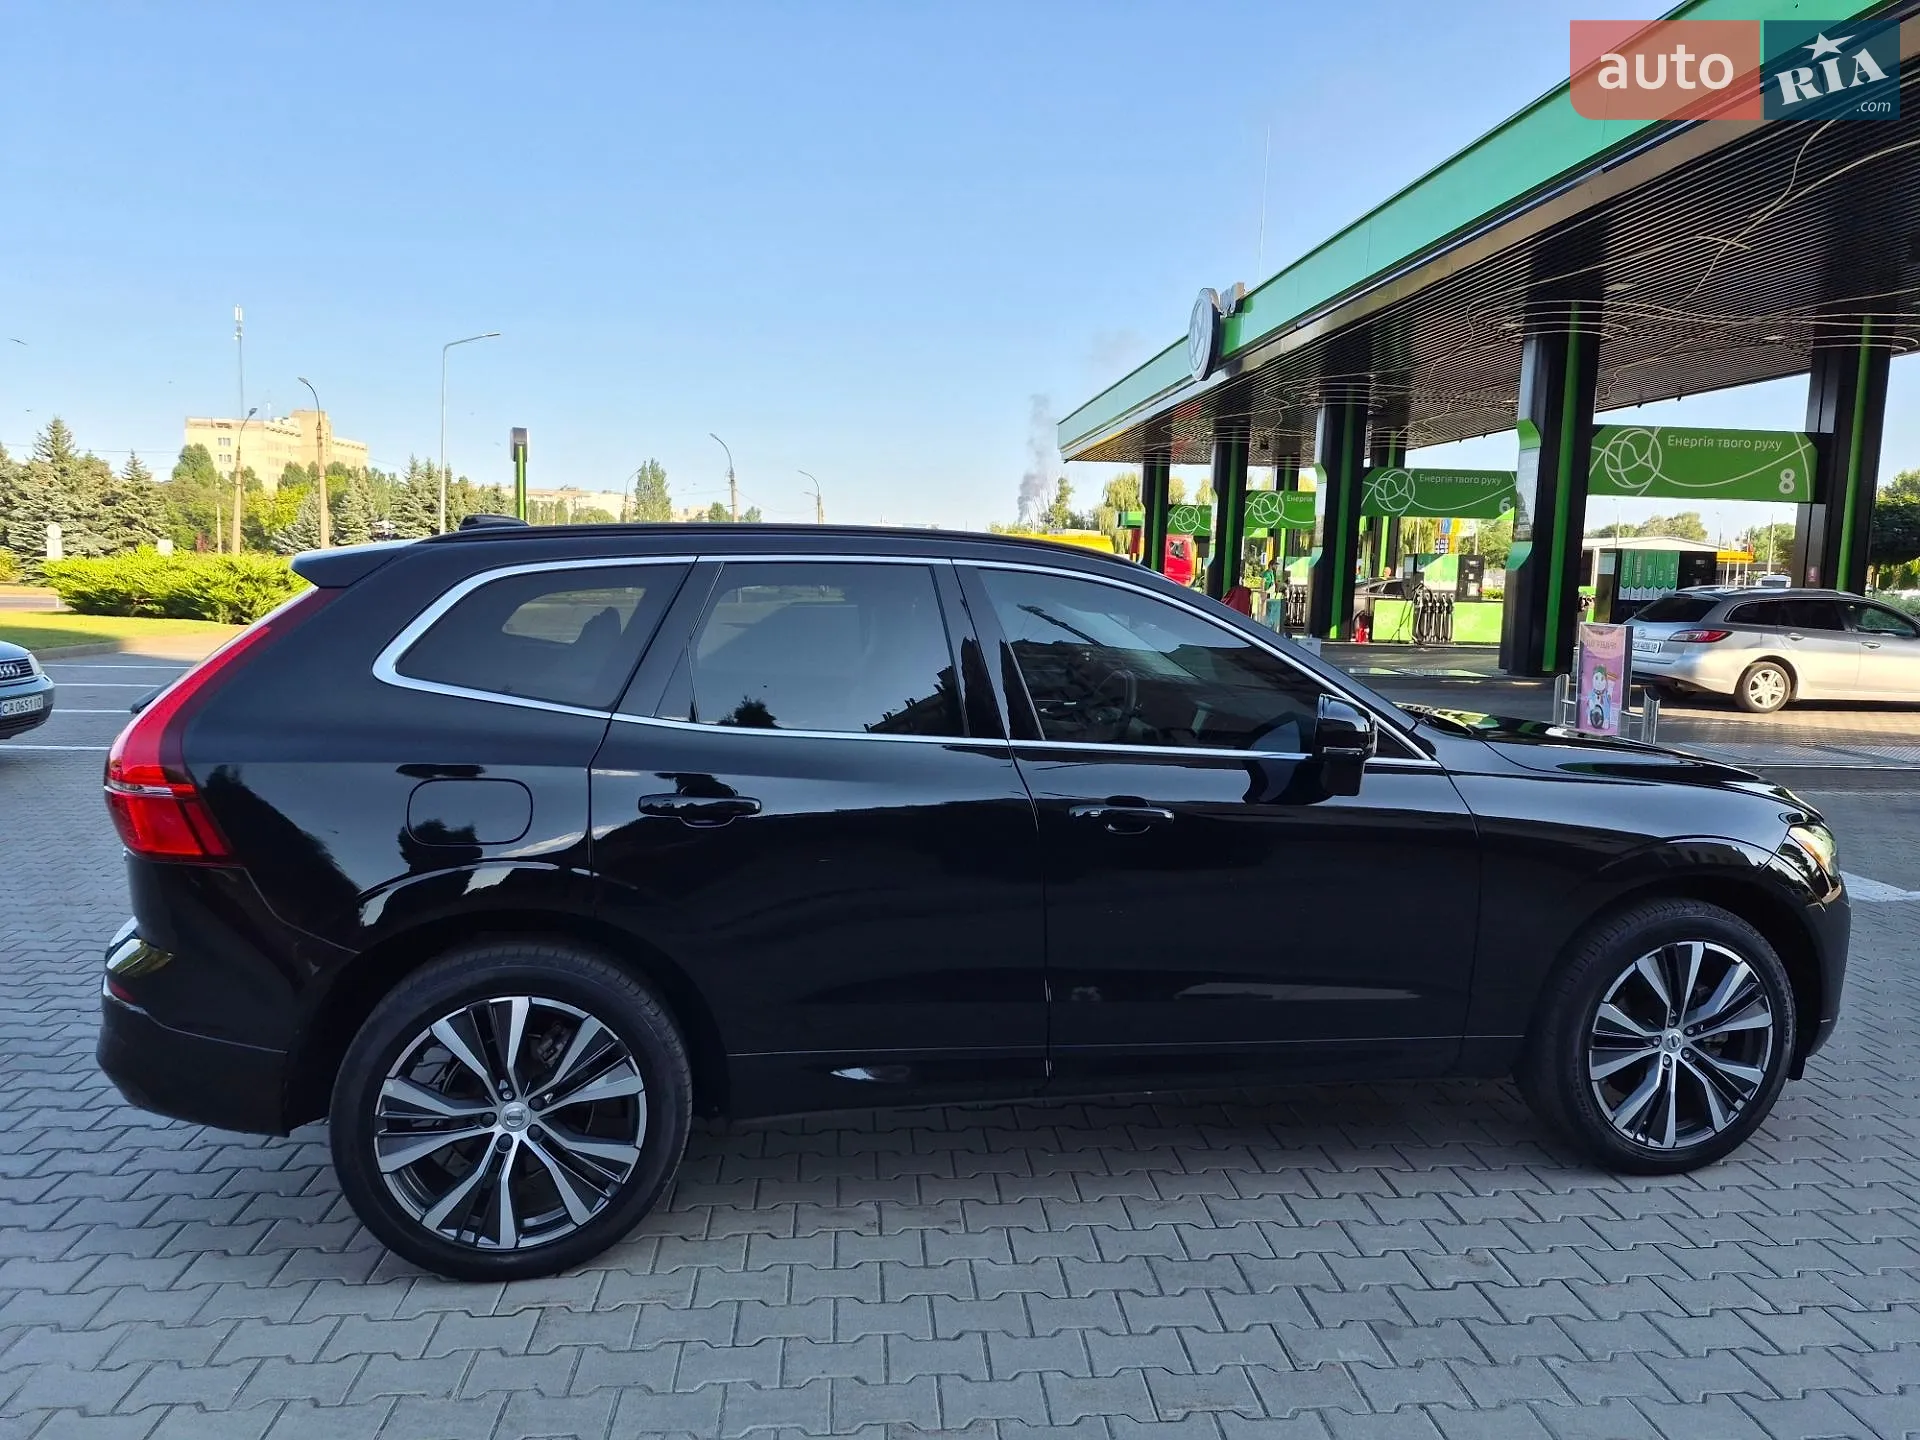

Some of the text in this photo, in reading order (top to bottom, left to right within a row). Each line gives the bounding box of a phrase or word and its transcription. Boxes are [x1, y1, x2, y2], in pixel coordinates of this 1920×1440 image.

[1667, 435, 1783, 451] Енергія твого руху
[1481, 477, 1503, 486] руху
[1779, 468, 1795, 494] 8
[1498, 496, 1511, 513] 6
